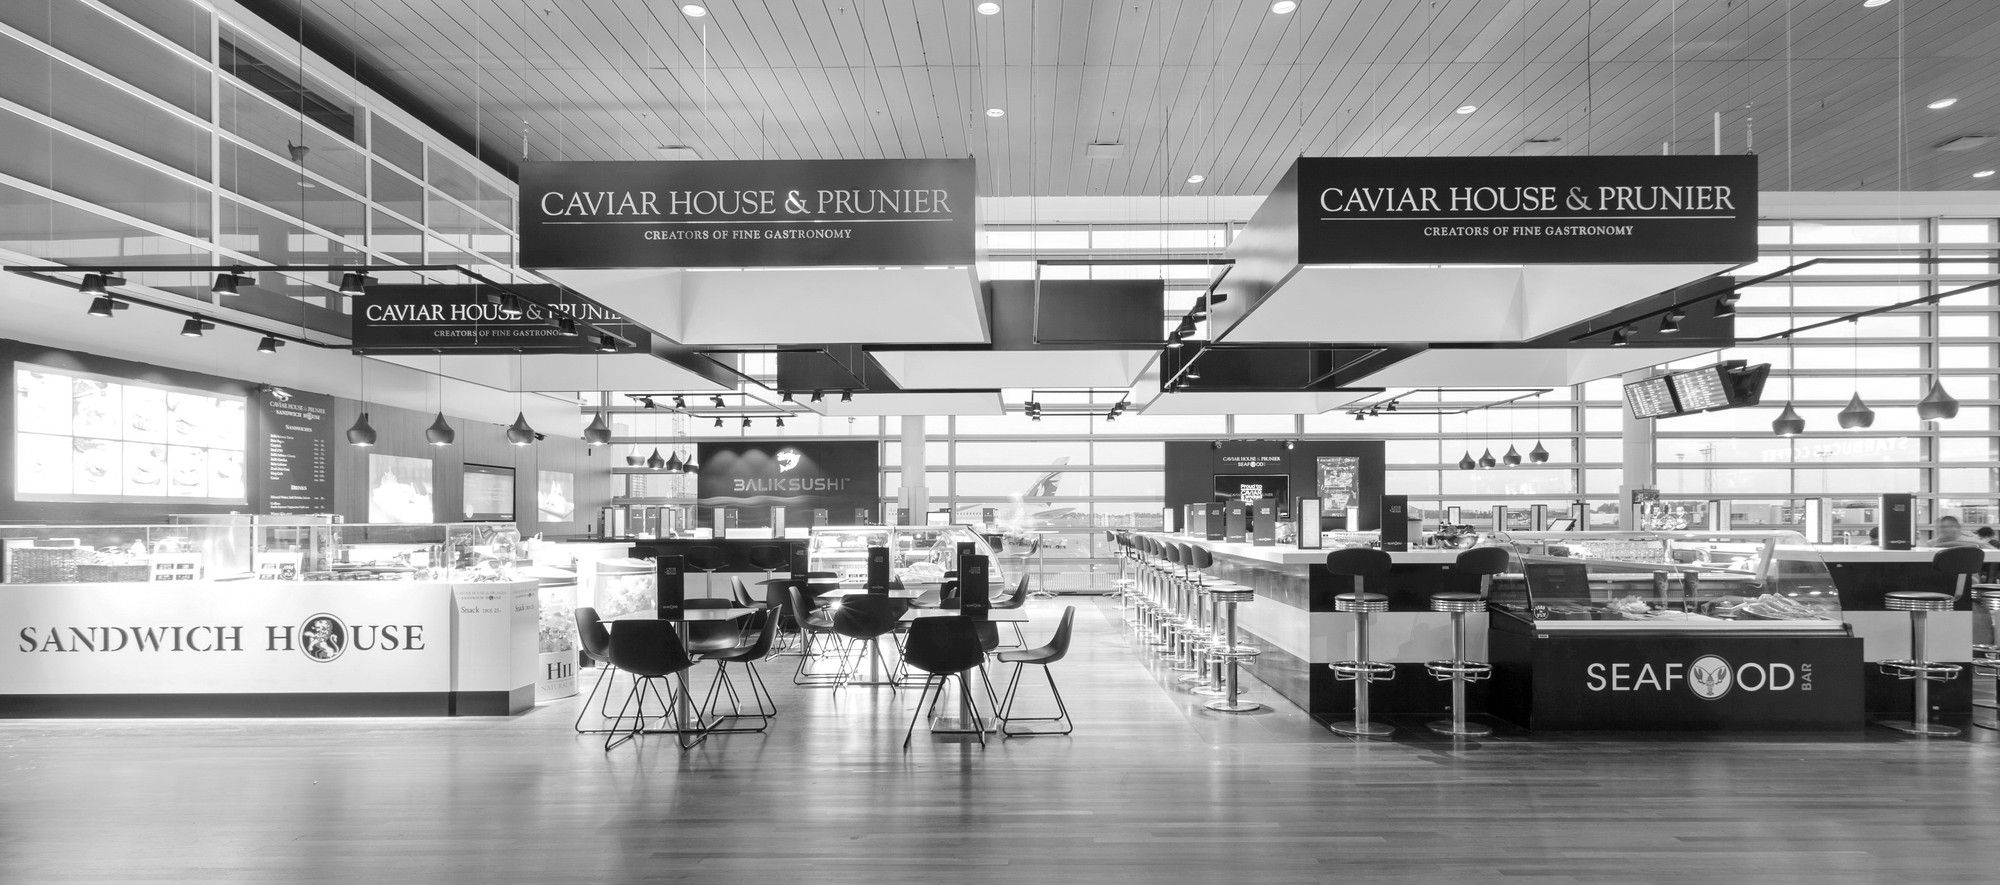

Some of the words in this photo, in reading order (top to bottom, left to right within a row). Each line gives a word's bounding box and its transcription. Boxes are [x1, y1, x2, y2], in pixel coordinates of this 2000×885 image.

[541, 191, 661, 216] CAVIAR
[669, 190, 776, 215] HOUSE
[784, 189, 811, 215] &
[817, 189, 953, 214] PRUNIER
[1320, 187, 1441, 212] CAVIAR
[1449, 187, 1558, 211] HOUSE
[1566, 186, 1593, 211] &
[1598, 185, 1736, 211] PRUNIER
[644, 230, 710, 241] CREATORS
[711, 230, 730, 240] OF
[732, 230, 761, 240] FINE
[763, 229, 852, 240] GASTRONOMY
[1423, 226, 1490, 237] CREATORS
[1492, 226, 1511, 236] OF
[1512, 226, 1542, 236] FINE
[1544, 225, 1634, 236] GASTRONOMY
[366, 304, 446, 321] CAVIAR
[526, 303, 544, 320] &
[433, 329, 477, 337] CREATORS
[478, 329, 490, 337] OF
[491, 329, 511, 337] FINE
[512, 328, 561, 337] GASTRONO
[18, 626, 244, 654] SANDWICH
[1801, 662, 1812, 692] BAR
